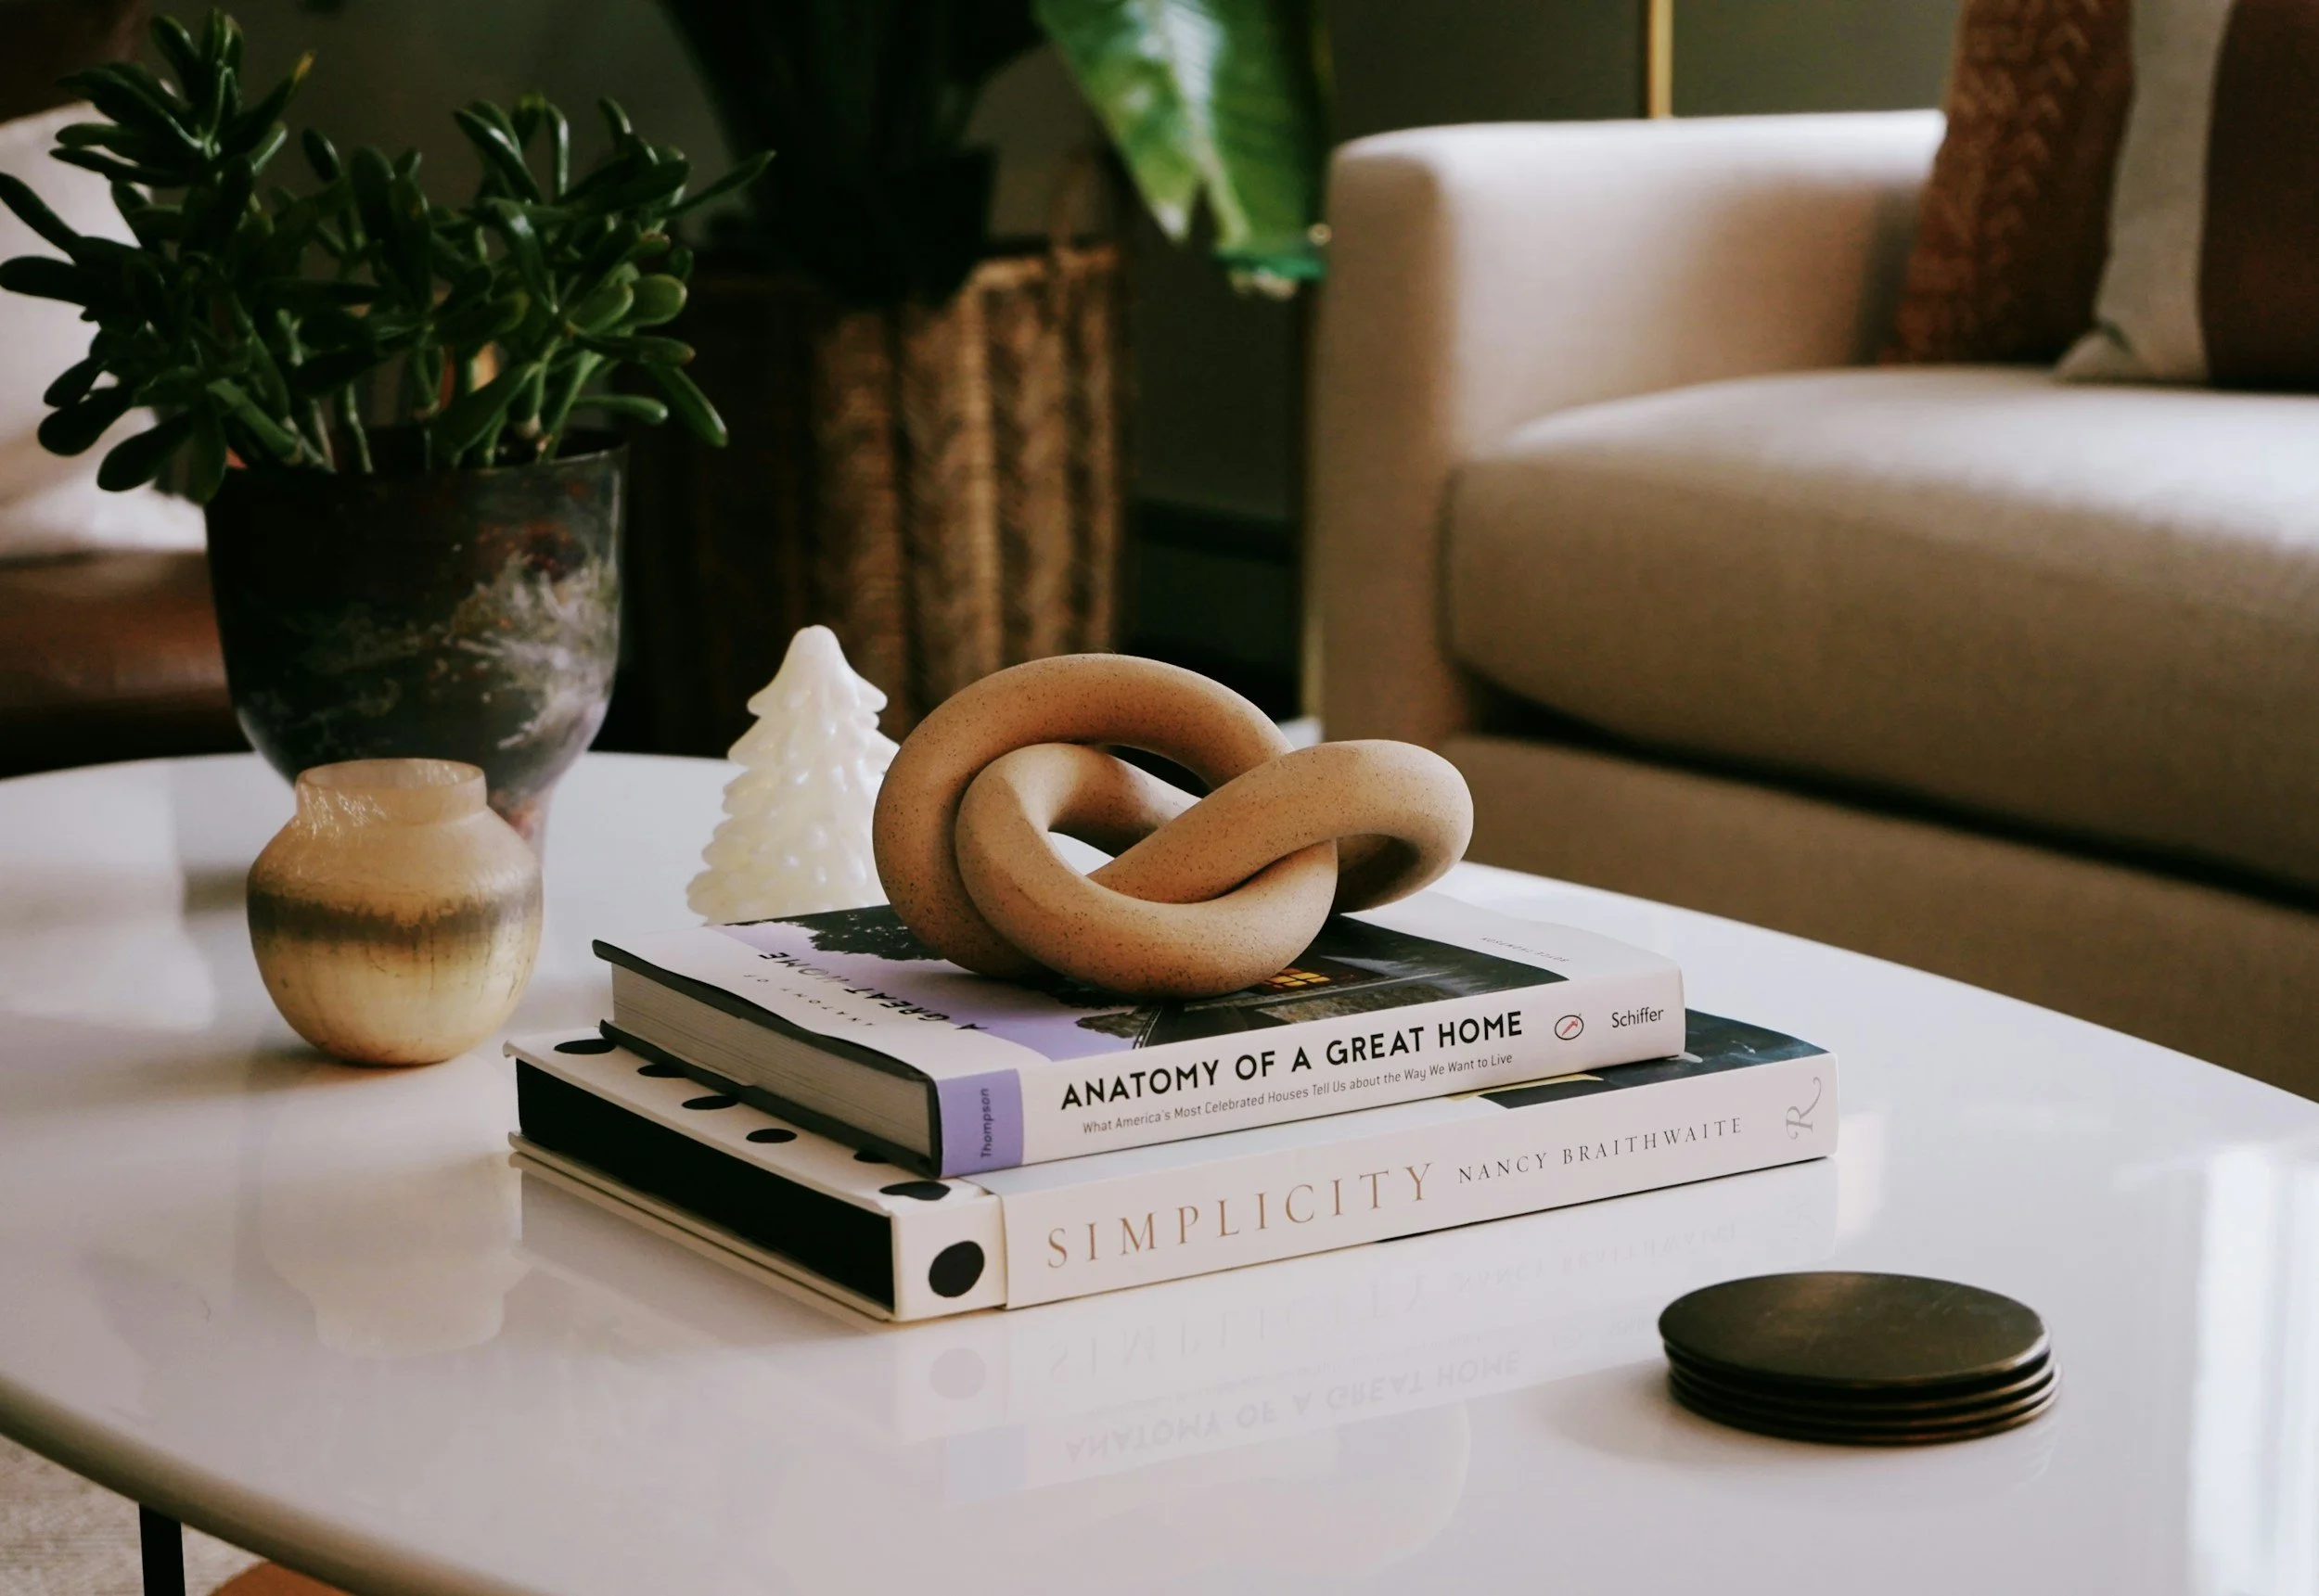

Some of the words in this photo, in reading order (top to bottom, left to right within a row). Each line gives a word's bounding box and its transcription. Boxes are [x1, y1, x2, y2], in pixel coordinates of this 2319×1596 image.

[758, 951, 851, 983] HOME
[842, 988, 950, 1021] GREAT
[1611, 1006, 1664, 1028] Schiffer
[1061, 1059, 1219, 1110] ANATOMY
[1236, 1051, 1275, 1080] OF
[1291, 1046, 1312, 1072] A
[1326, 1027, 1424, 1066] GREAT
[1438, 1011, 1522, 1048] HOME
[1083, 1120, 1112, 1134] What
[1115, 1109, 1171, 1129] America's
[1174, 1105, 1202, 1119] Most
[1205, 1093, 1264, 1114] Celebrated
[1268, 1088, 1309, 1104] Houses
[1313, 1082, 1329, 1095] Tell
[1332, 1080, 1346, 1092] Us
[1350, 1076, 1381, 1091] about
[1384, 1071, 1401, 1083] the
[1403, 1068, 1427, 1081] Way
[1429, 1064, 1445, 1076] We
[1448, 1059, 1475, 1073] Want
[1478, 1056, 1488, 1068] to
[1491, 1053, 1512, 1066] Live
[980, 1088, 994, 1158] Thompson
[1786, 1077, 1822, 1140] R
[1047, 1162, 1434, 1269] SIMPLICITY
[1458, 1153, 1547, 1184] NANCY
[1563, 1117, 1742, 1165] BRAITHWAITE
